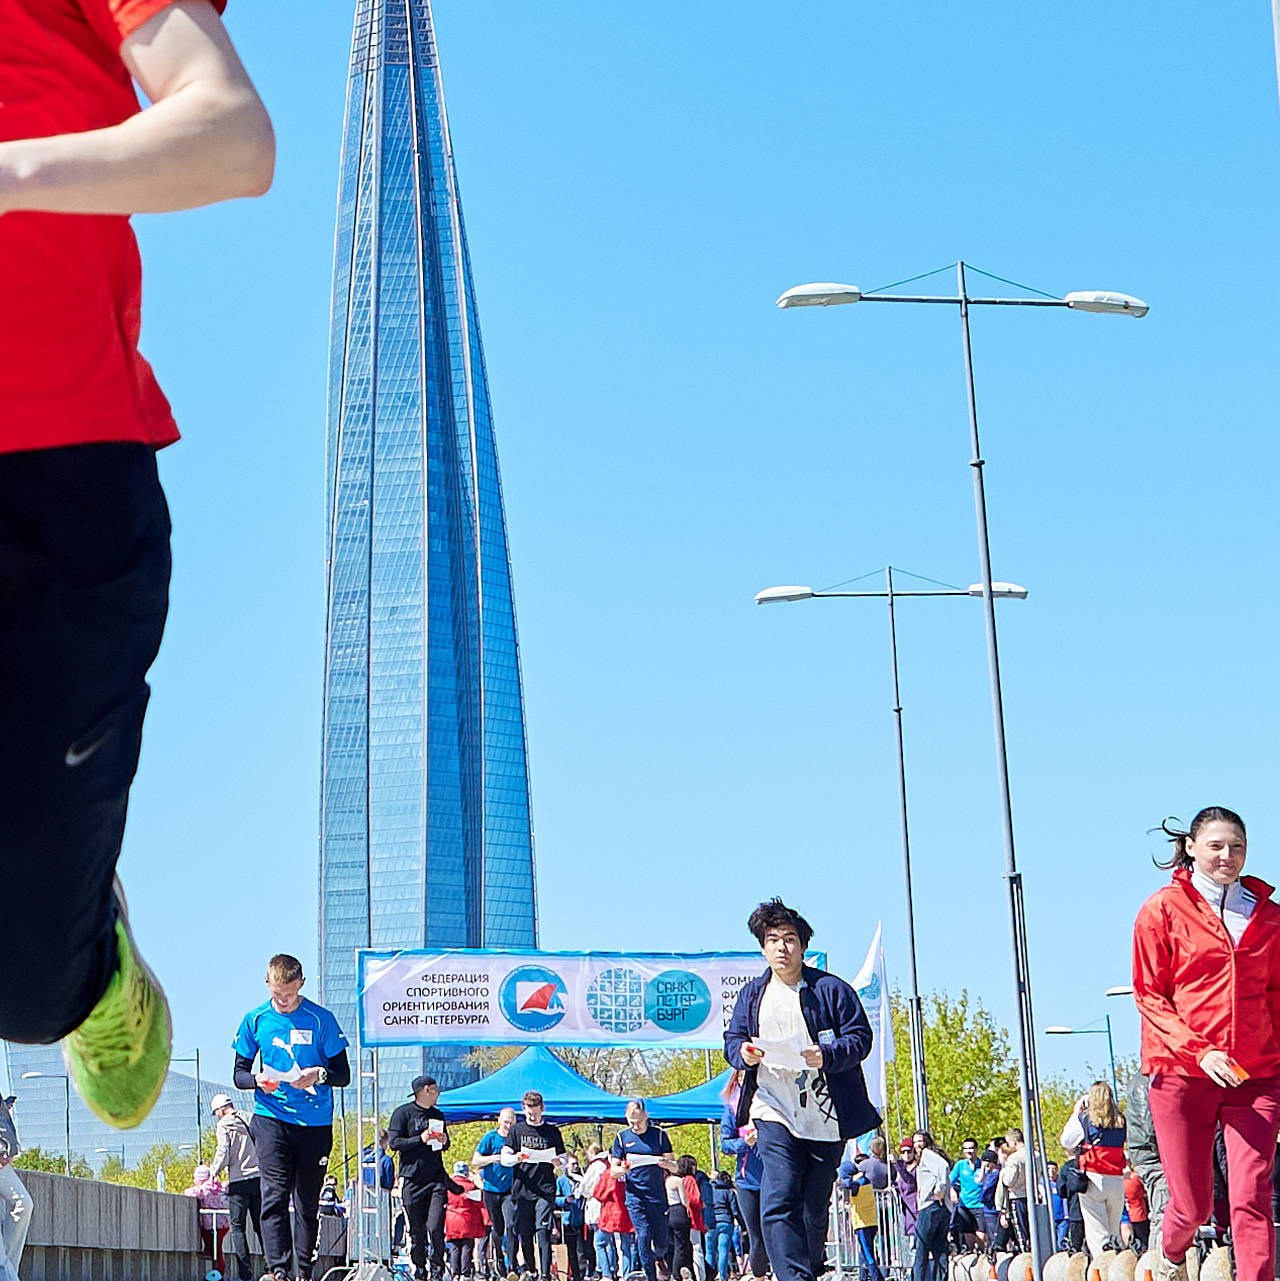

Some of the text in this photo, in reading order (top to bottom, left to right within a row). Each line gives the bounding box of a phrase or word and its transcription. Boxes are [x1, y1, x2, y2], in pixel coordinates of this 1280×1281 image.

[421, 973, 489, 984] ФЕДЕРАЦИЯ
[656, 979, 695, 993] САНКТ
[406, 987, 489, 997] СПОРТИВНОГО
[721, 990, 739, 999] ФИ
[656, 993, 697, 1007] ПЕТЕР
[382, 1001, 489, 1012] ОРИЕНТИРОВАНИЯ
[383, 1014, 489, 1025] САНКТ-ПЕТЕРБУРГА
[656, 1007, 689, 1021] БУРГ
